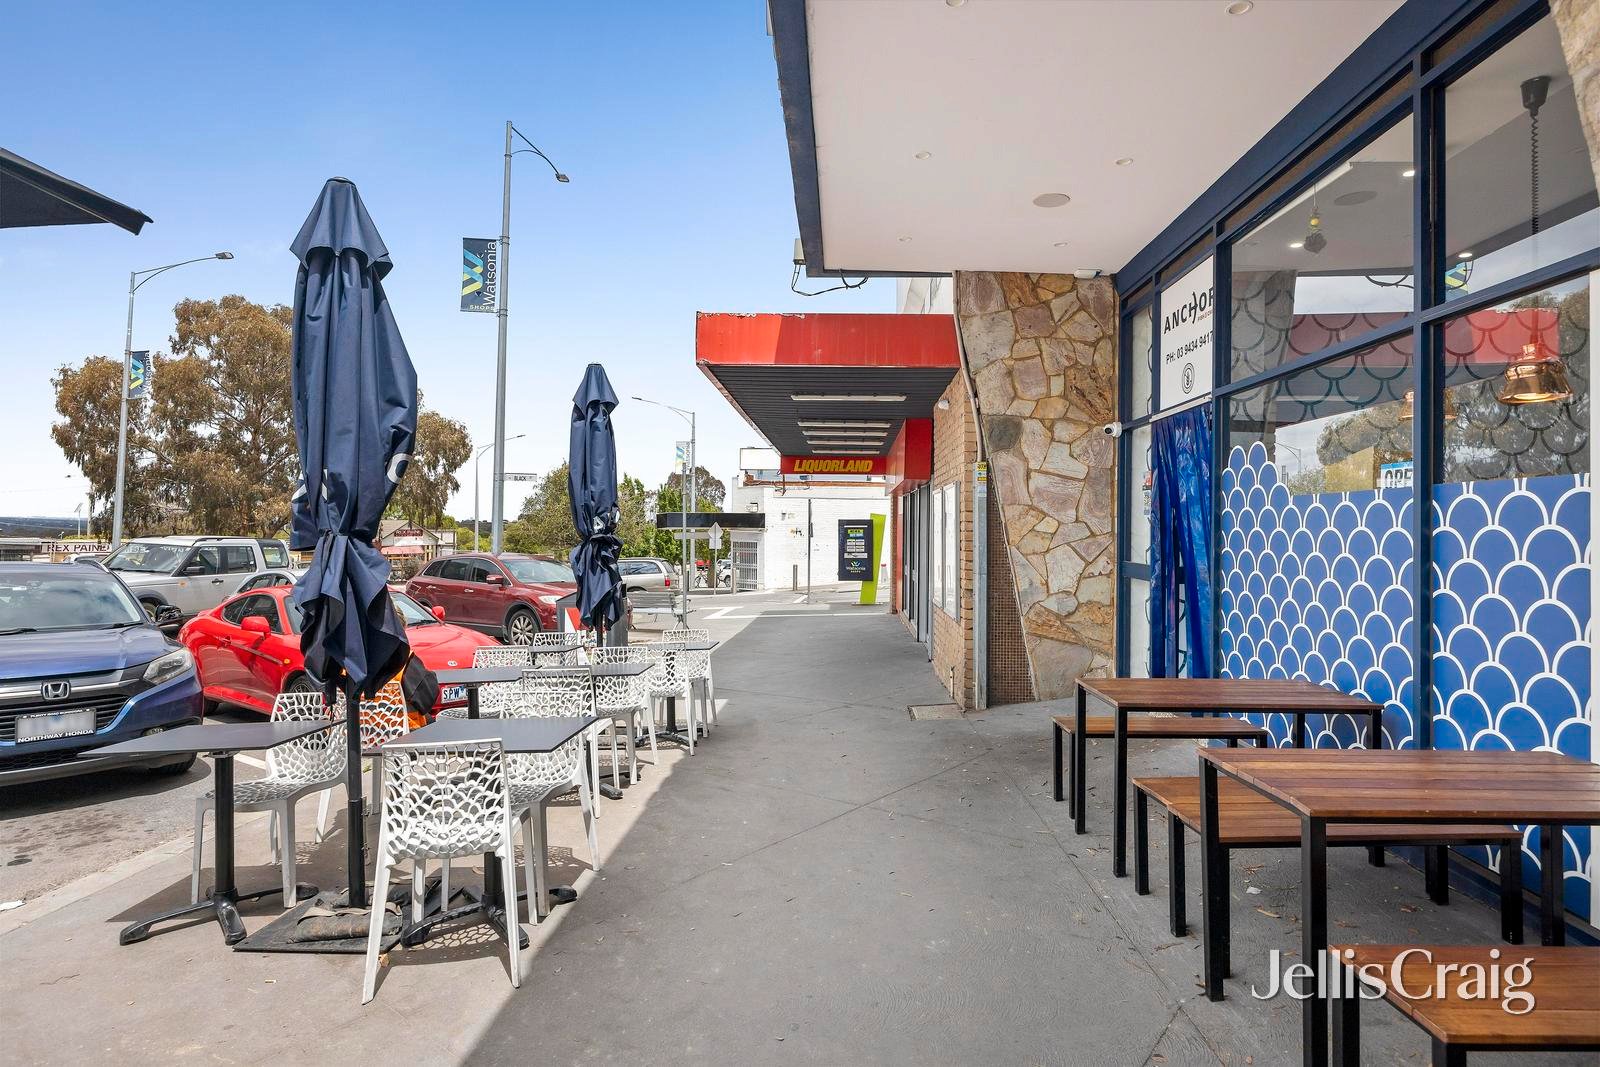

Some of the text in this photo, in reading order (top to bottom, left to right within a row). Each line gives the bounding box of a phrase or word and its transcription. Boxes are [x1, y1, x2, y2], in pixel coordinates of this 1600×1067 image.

[483, 241, 497, 306] Watsonia
[1176, 346, 1184, 359] 03
[793, 459, 874, 473] LIQUORLAND
[47, 544, 70, 552] REX
[17, 729, 94, 743] NORTHWAY HONDA
